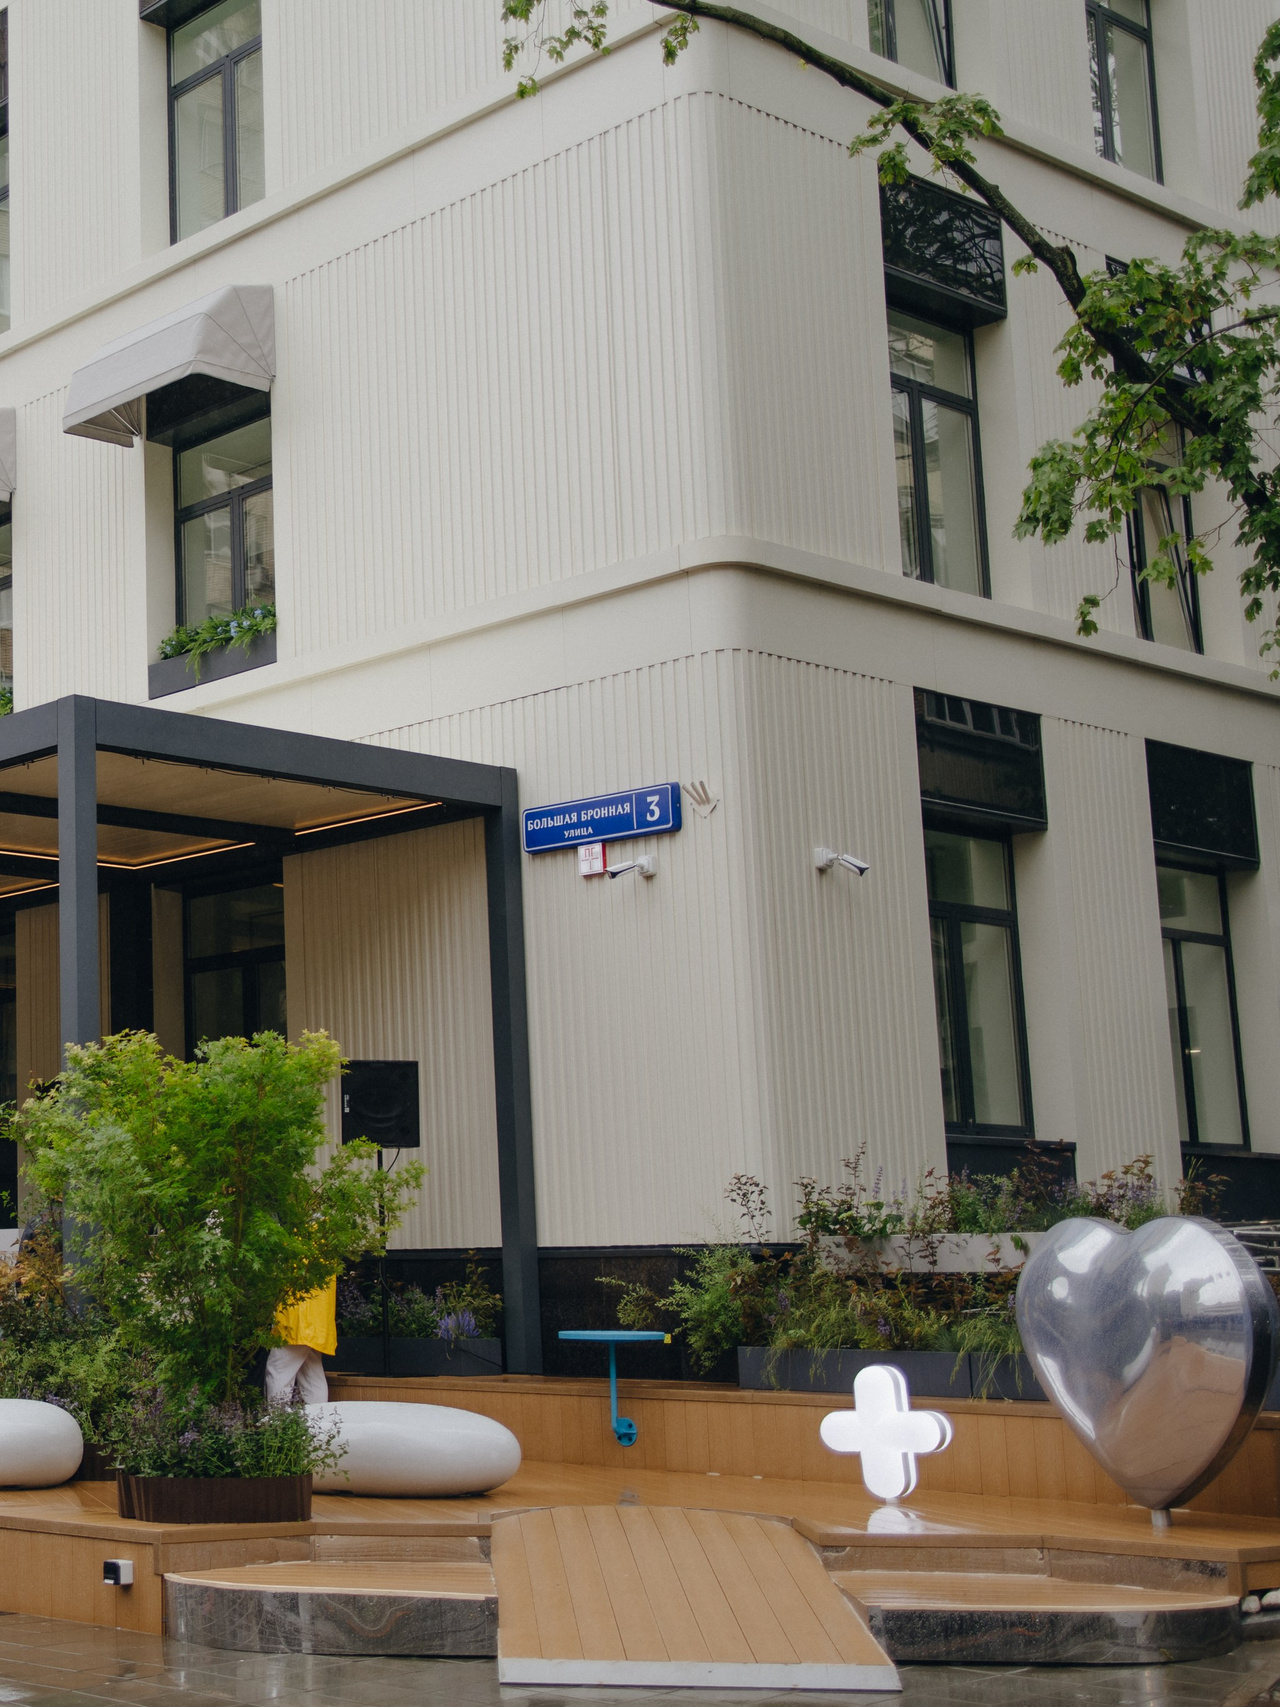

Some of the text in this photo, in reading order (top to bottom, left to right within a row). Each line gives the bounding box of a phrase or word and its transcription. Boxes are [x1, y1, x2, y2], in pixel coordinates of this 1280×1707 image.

[527, 802, 631, 831] БОЛЬШАЯ БРОННАЯ
[646, 795, 660, 822] 3
[563, 826, 594, 839] УЛИЦА
[584, 846, 596, 859] ПГ
